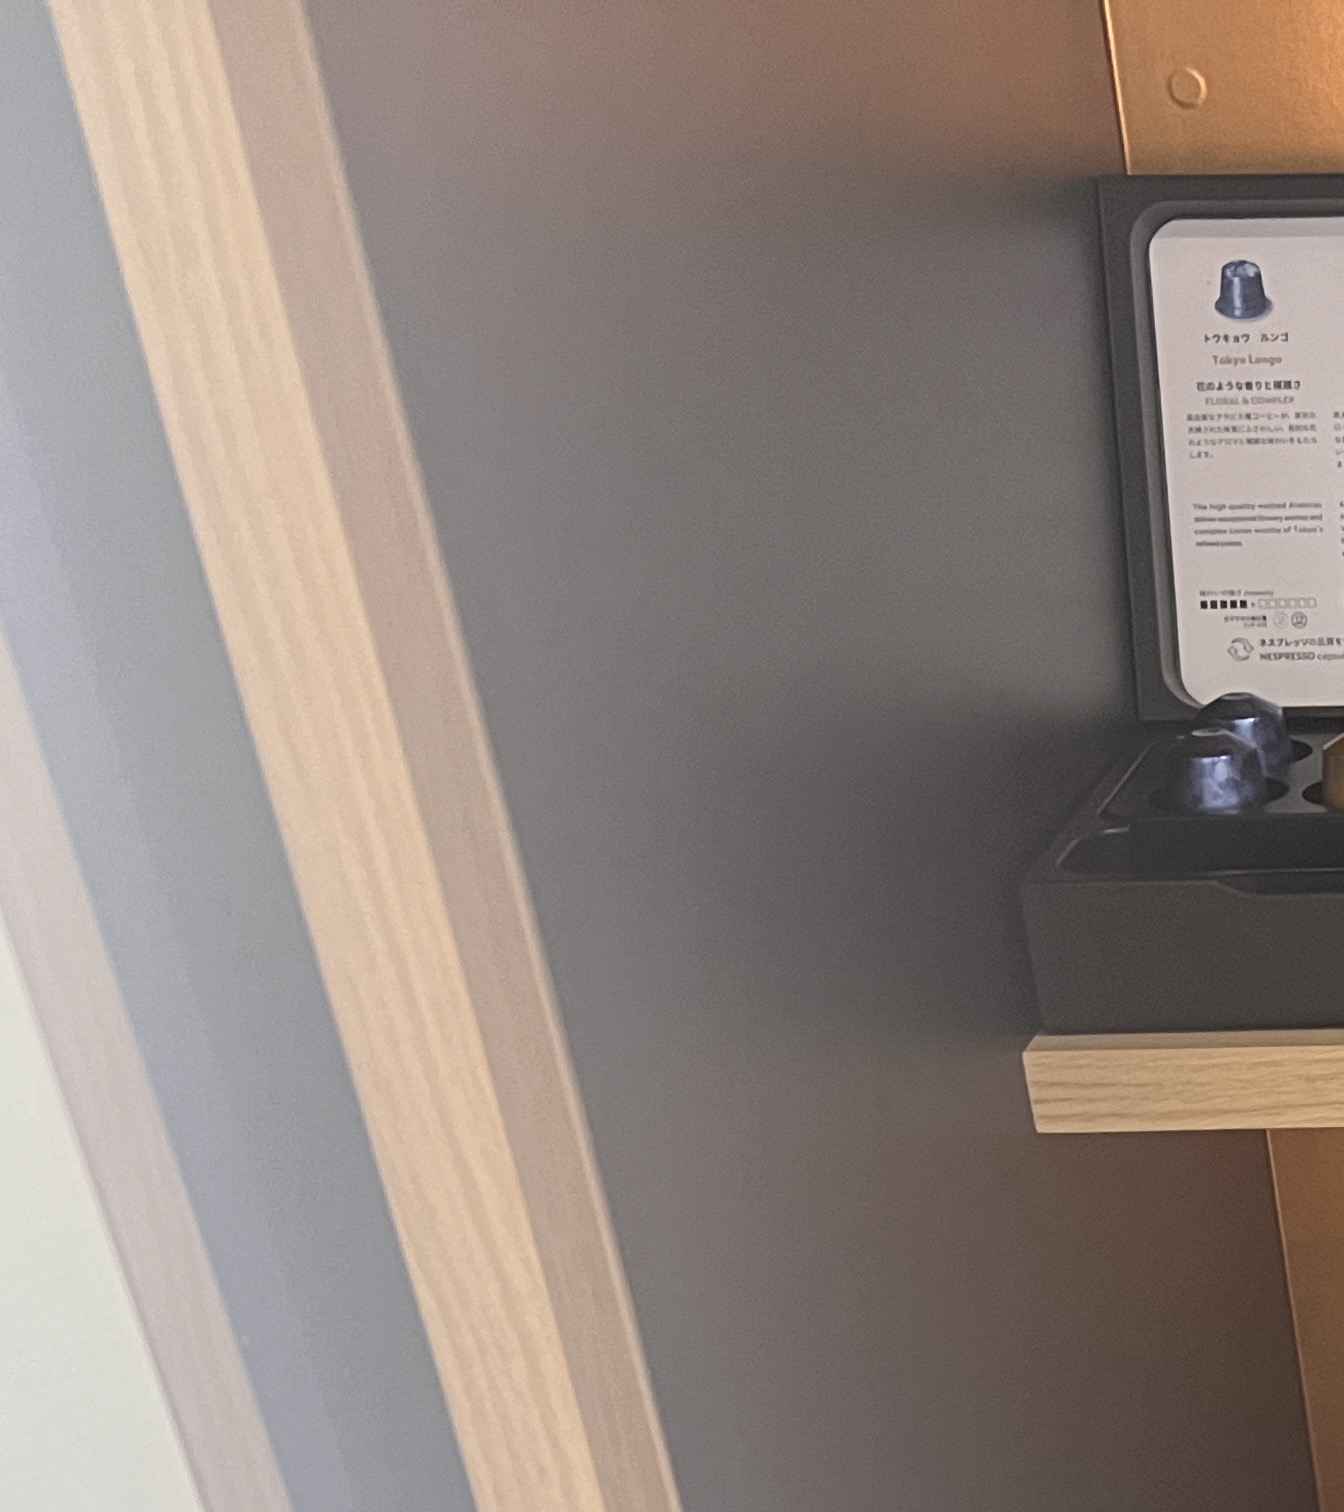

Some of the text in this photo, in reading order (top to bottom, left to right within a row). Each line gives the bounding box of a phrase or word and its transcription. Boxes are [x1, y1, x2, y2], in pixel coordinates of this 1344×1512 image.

[1204, 331, 1289, 343] トウキョウ ルンゴ
[1212, 353, 1283, 366] Tokyo Lungo
[1259, 651, 1316, 661] NESPRESSO
